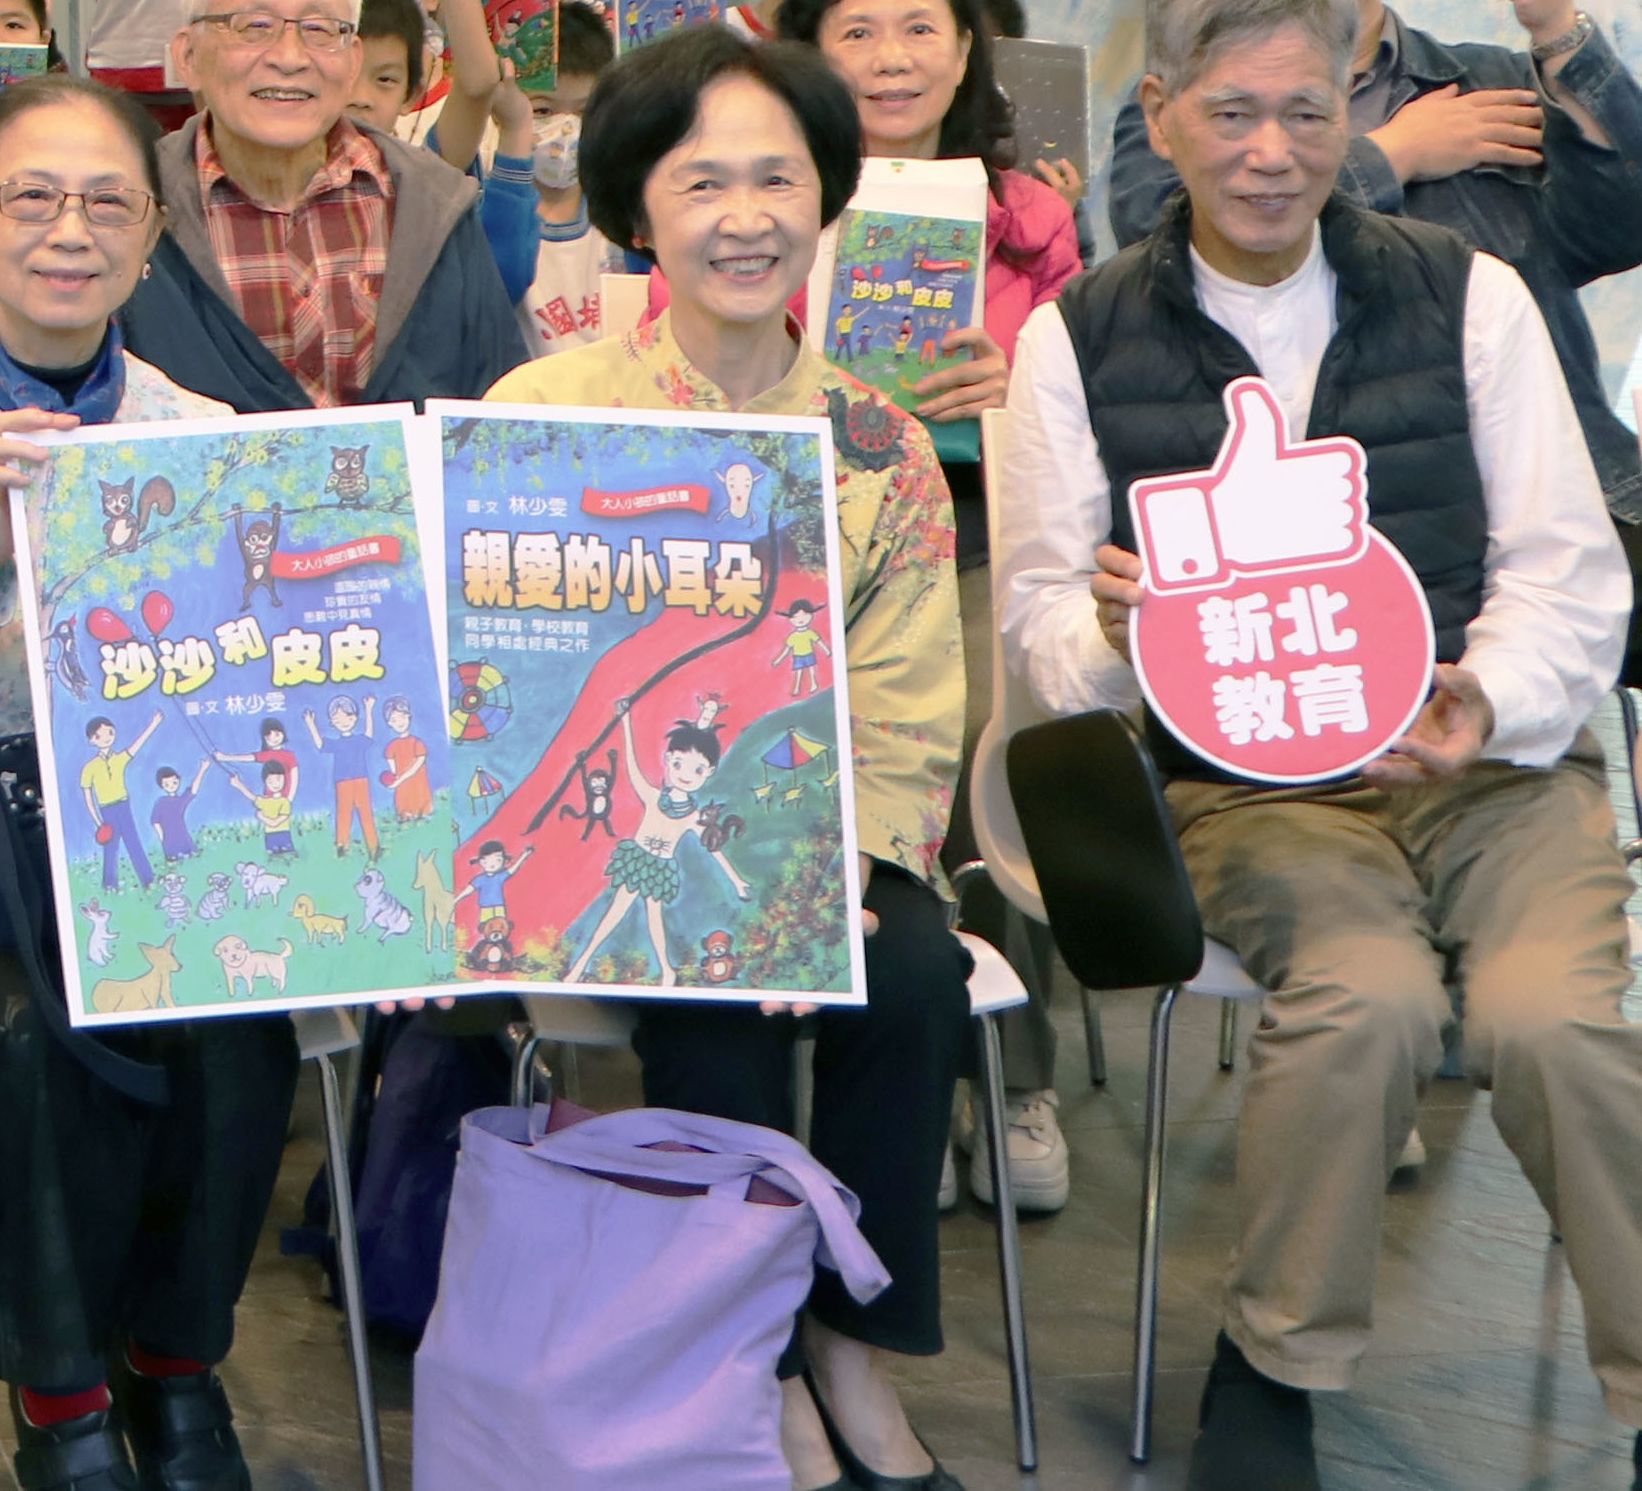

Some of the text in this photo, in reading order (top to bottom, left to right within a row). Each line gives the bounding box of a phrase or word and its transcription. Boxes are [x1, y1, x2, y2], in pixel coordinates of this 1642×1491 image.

[851, 278, 955, 309] 沙沙和皮皮
[508, 496, 568, 517] 林少雯
[461, 529, 764, 616] 親愛的小耳朵
[465, 634, 591, 653] 同學相處經典之作
[1197, 584, 1358, 667] 新北
[100, 615, 386, 700] 沙沙和皮皮
[224, 691, 286, 715] 林少雯
[1213, 663, 1369, 746] 教育
